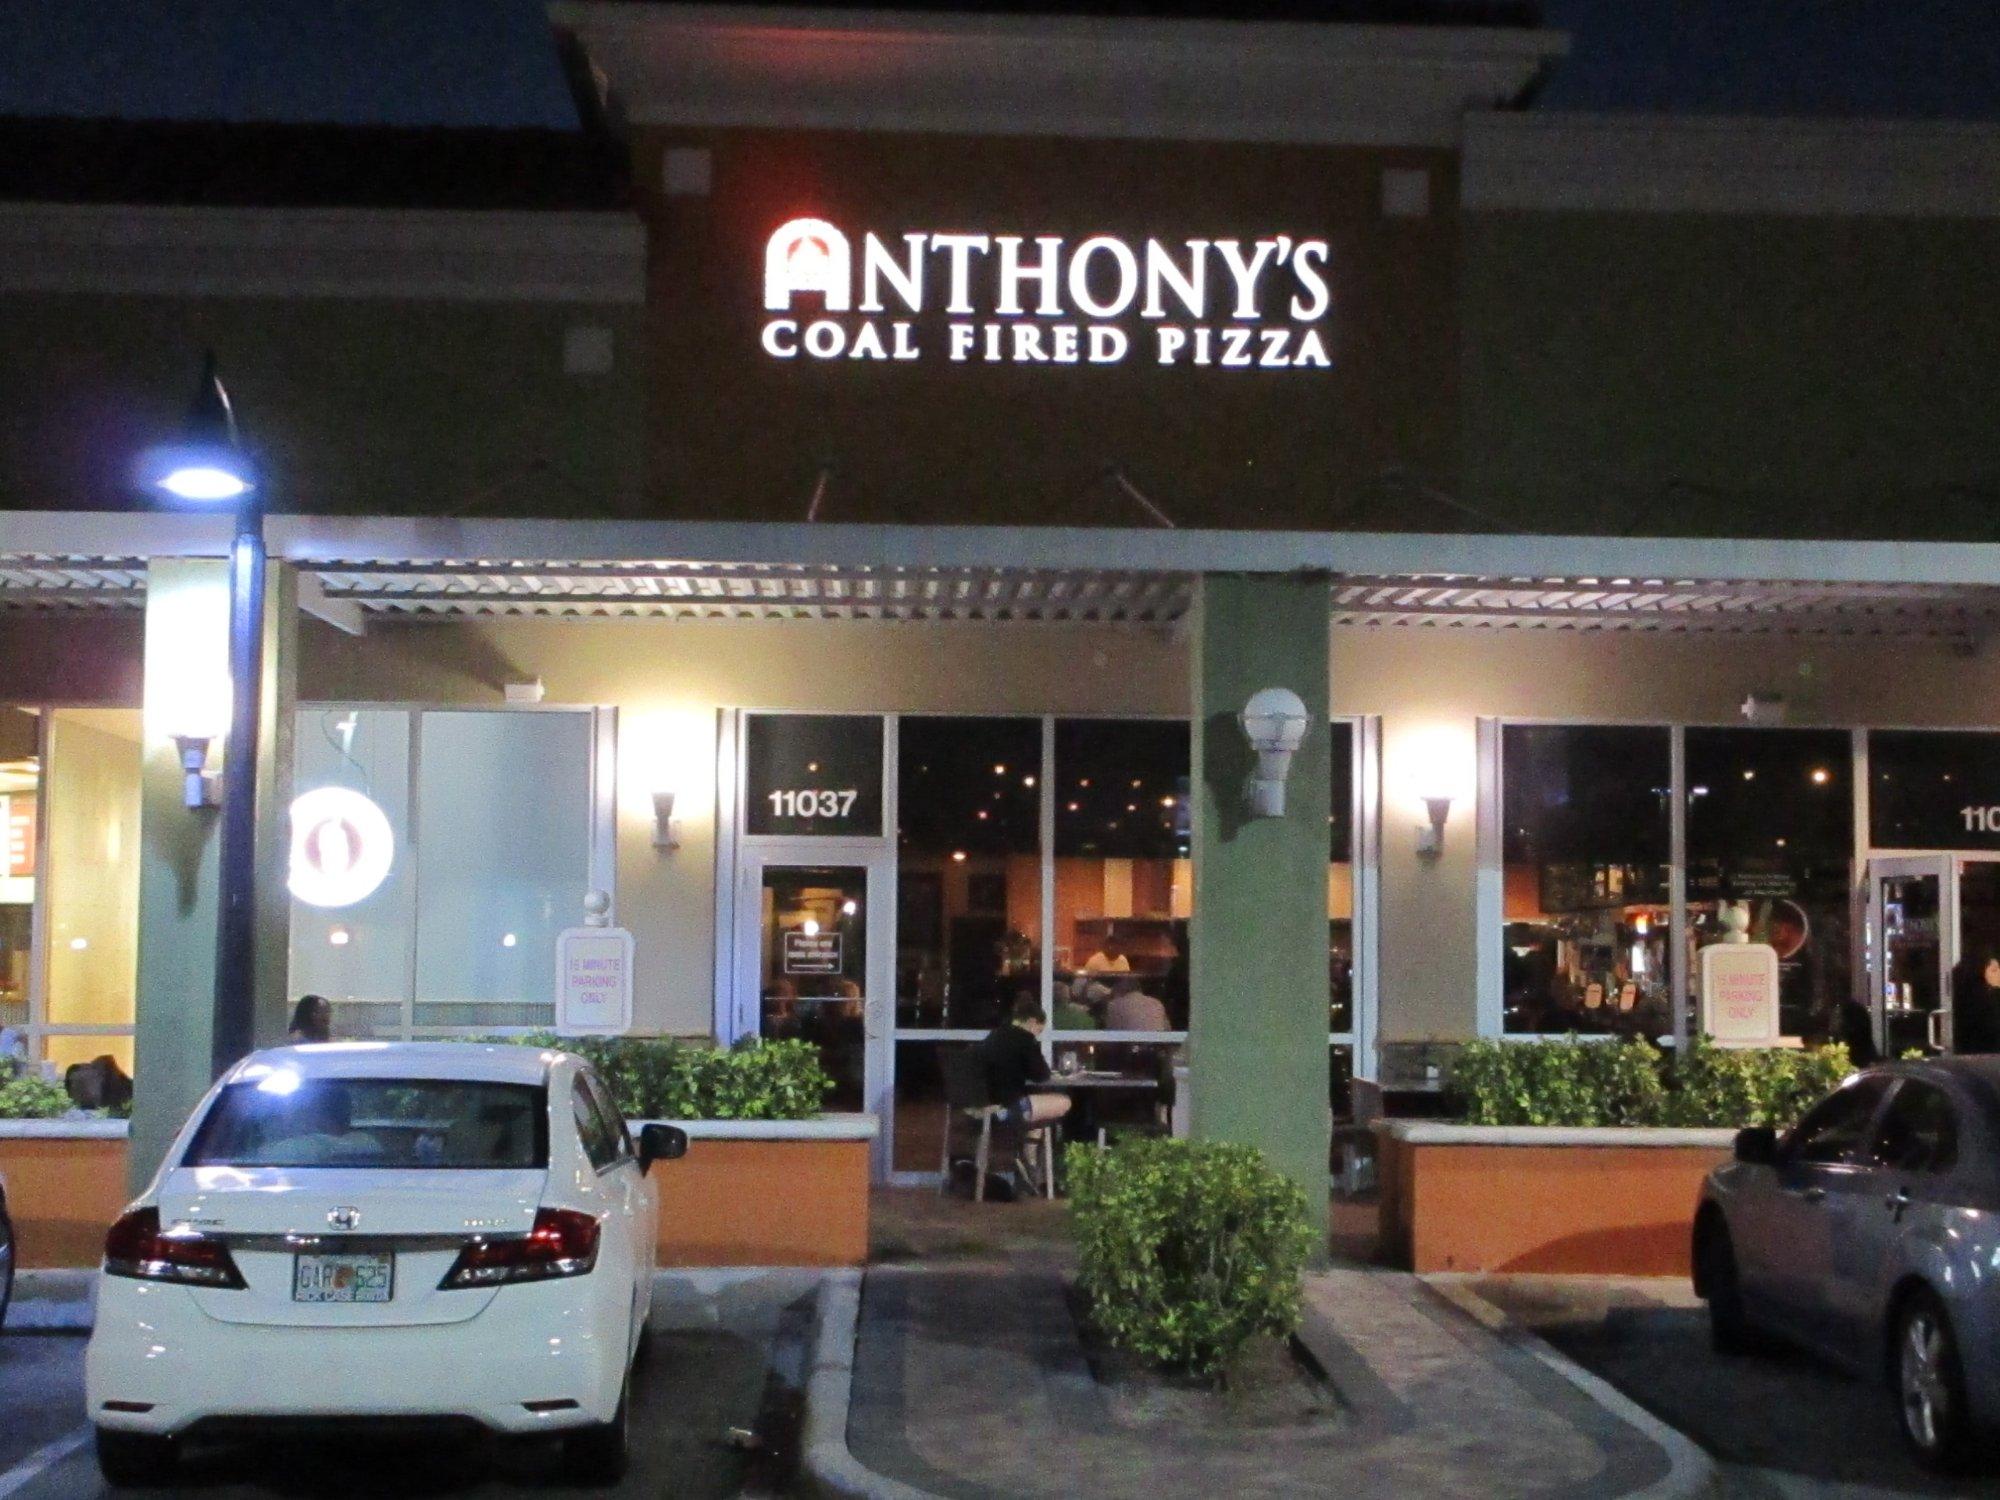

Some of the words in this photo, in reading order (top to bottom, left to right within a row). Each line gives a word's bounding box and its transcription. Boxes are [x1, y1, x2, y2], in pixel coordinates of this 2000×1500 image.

[764, 217, 1329, 322] ANTHONY'S
[761, 319, 919, 360] COAL
[949, 323, 1128, 363] FIRED
[1156, 326, 1331, 367] PIZZA
[768, 789, 858, 818] 11037
[582, 958, 620, 971] MINUTE
[571, 975, 617, 988] PARKING
